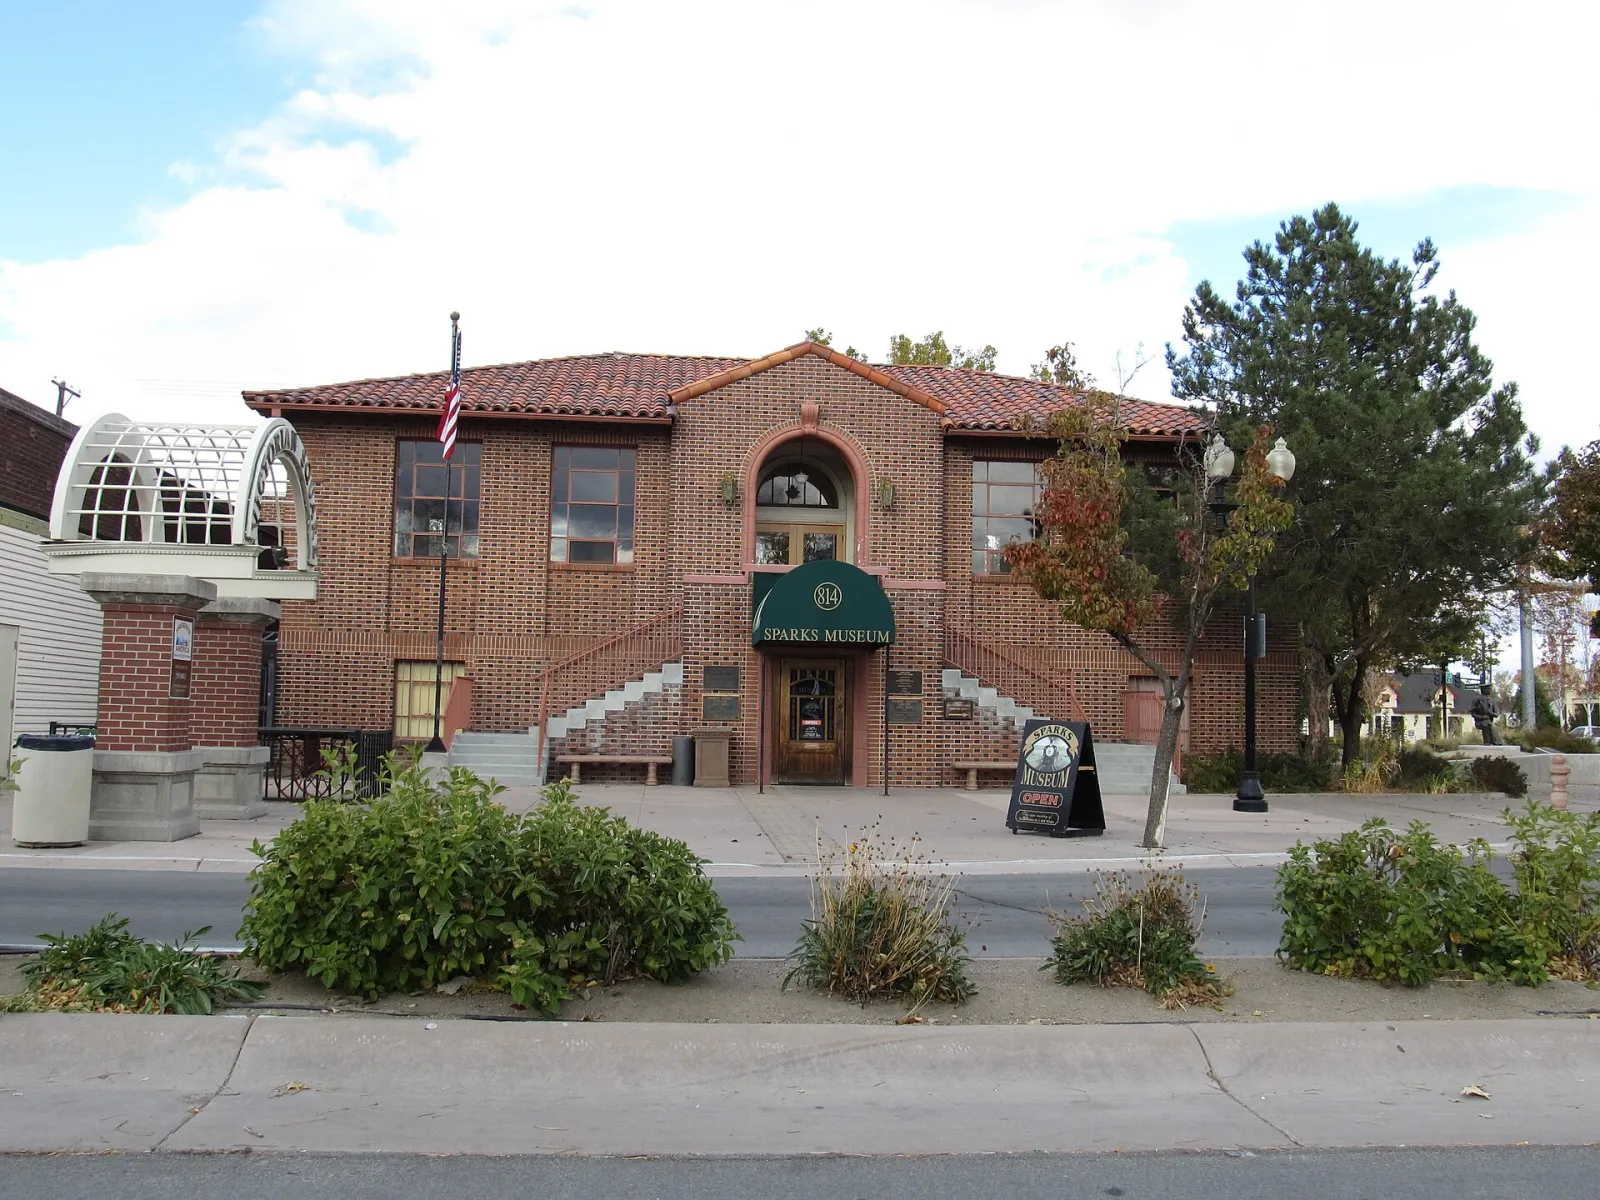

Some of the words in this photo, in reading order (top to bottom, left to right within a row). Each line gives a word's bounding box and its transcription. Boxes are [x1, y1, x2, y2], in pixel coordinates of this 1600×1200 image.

[817, 587, 839, 605] 814
[764, 628, 819, 641] SPARKS
[824, 629, 890, 643] MUSEUM
[1033, 725, 1074, 741] SPARKS
[1020, 764, 1071, 788] MUSEUM
[1023, 792, 1059, 806] OPEN
